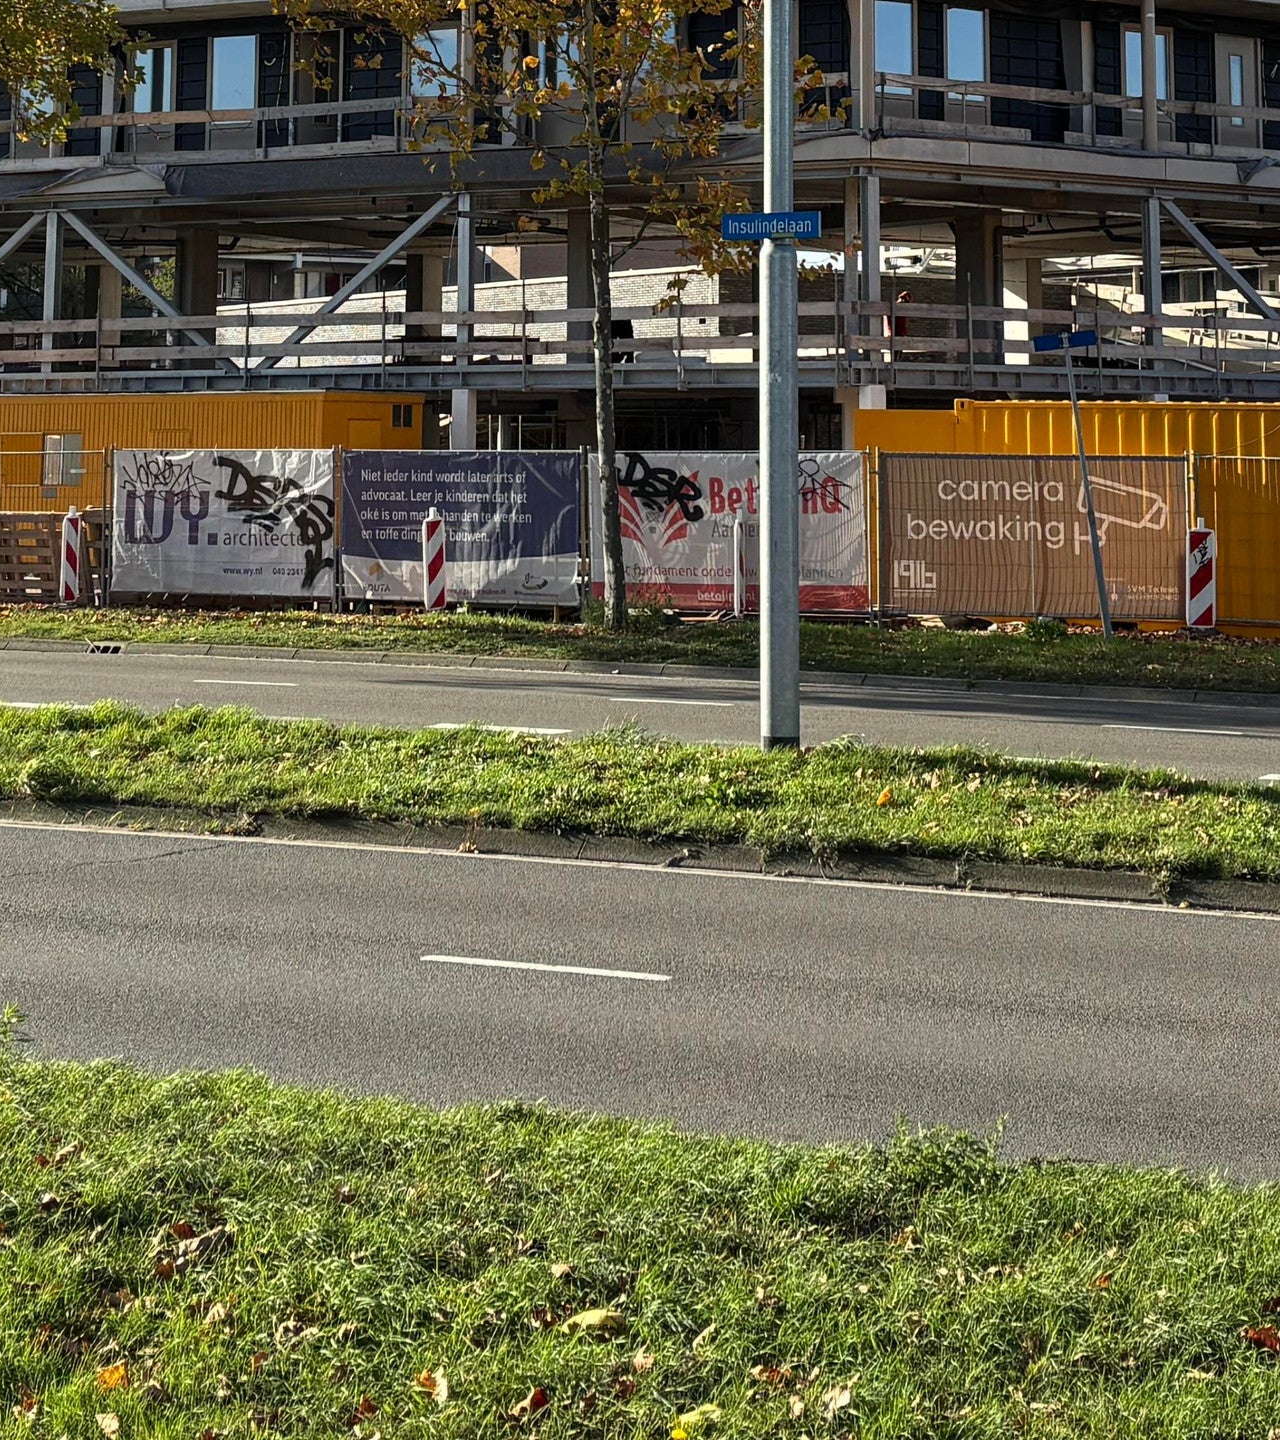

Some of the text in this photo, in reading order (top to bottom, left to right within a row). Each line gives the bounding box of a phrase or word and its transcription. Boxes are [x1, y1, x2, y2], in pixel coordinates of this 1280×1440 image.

[728, 219, 812, 234] Insulindelaan
[361, 469, 527, 484] Niet ieder kind wordt later arts of
[361, 489, 527, 504] advocaat. Leer je kinderen dat het
[937, 480, 1064, 501] camera
[361, 507, 379, 520] oké
[381, 509, 390, 520] is
[392, 512, 408, 521] om
[443, 509, 479, 522] handen
[480, 512, 491, 522] te
[361, 531, 372, 539] en
[375, 529, 399, 539] toffe
[449, 529, 490, 542] bouwen.
[907, 515, 1065, 549] bewaking
[222, 565, 263, 578] www.wy.nl
[634, 563, 697, 579] fundament
